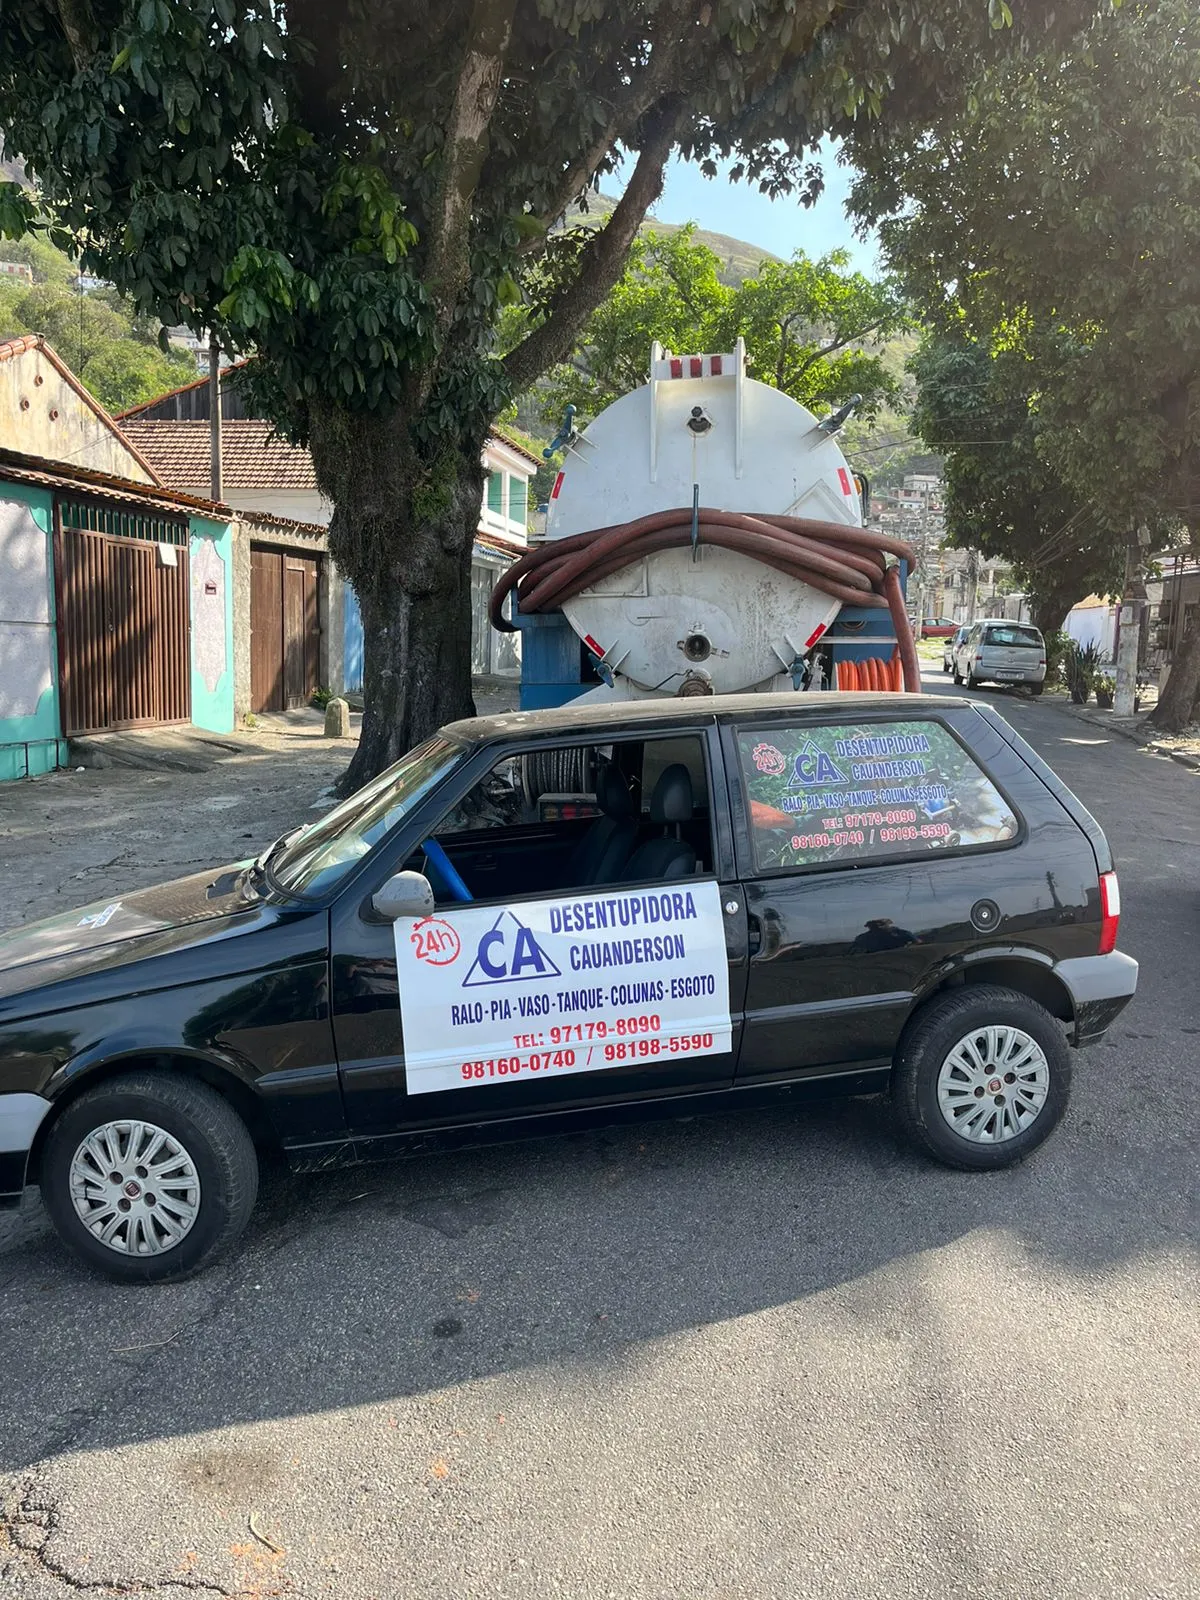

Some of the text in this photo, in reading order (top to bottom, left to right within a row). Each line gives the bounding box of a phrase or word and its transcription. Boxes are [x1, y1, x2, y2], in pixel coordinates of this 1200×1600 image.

[835, 735, 929, 756] DESENTUPIDORA
[795, 752, 839, 783] CA
[852, 760, 925, 780] CAUANDERSON
[822, 810, 916, 828] TEL: 97179-8090
[791, 832, 864, 849] 98160-0740
[880, 824, 950, 841] 98198-5590
[550, 892, 697, 933] DESENTUPIDORA
[410, 928, 453, 958] 24h
[478, 927, 546, 978] CA
[570, 935, 685, 971] CAUANDERSON
[514, 1015, 660, 1048] TEL: 97179-8090
[461, 1034, 712, 1080] 98160-0740 / 98198-5590
